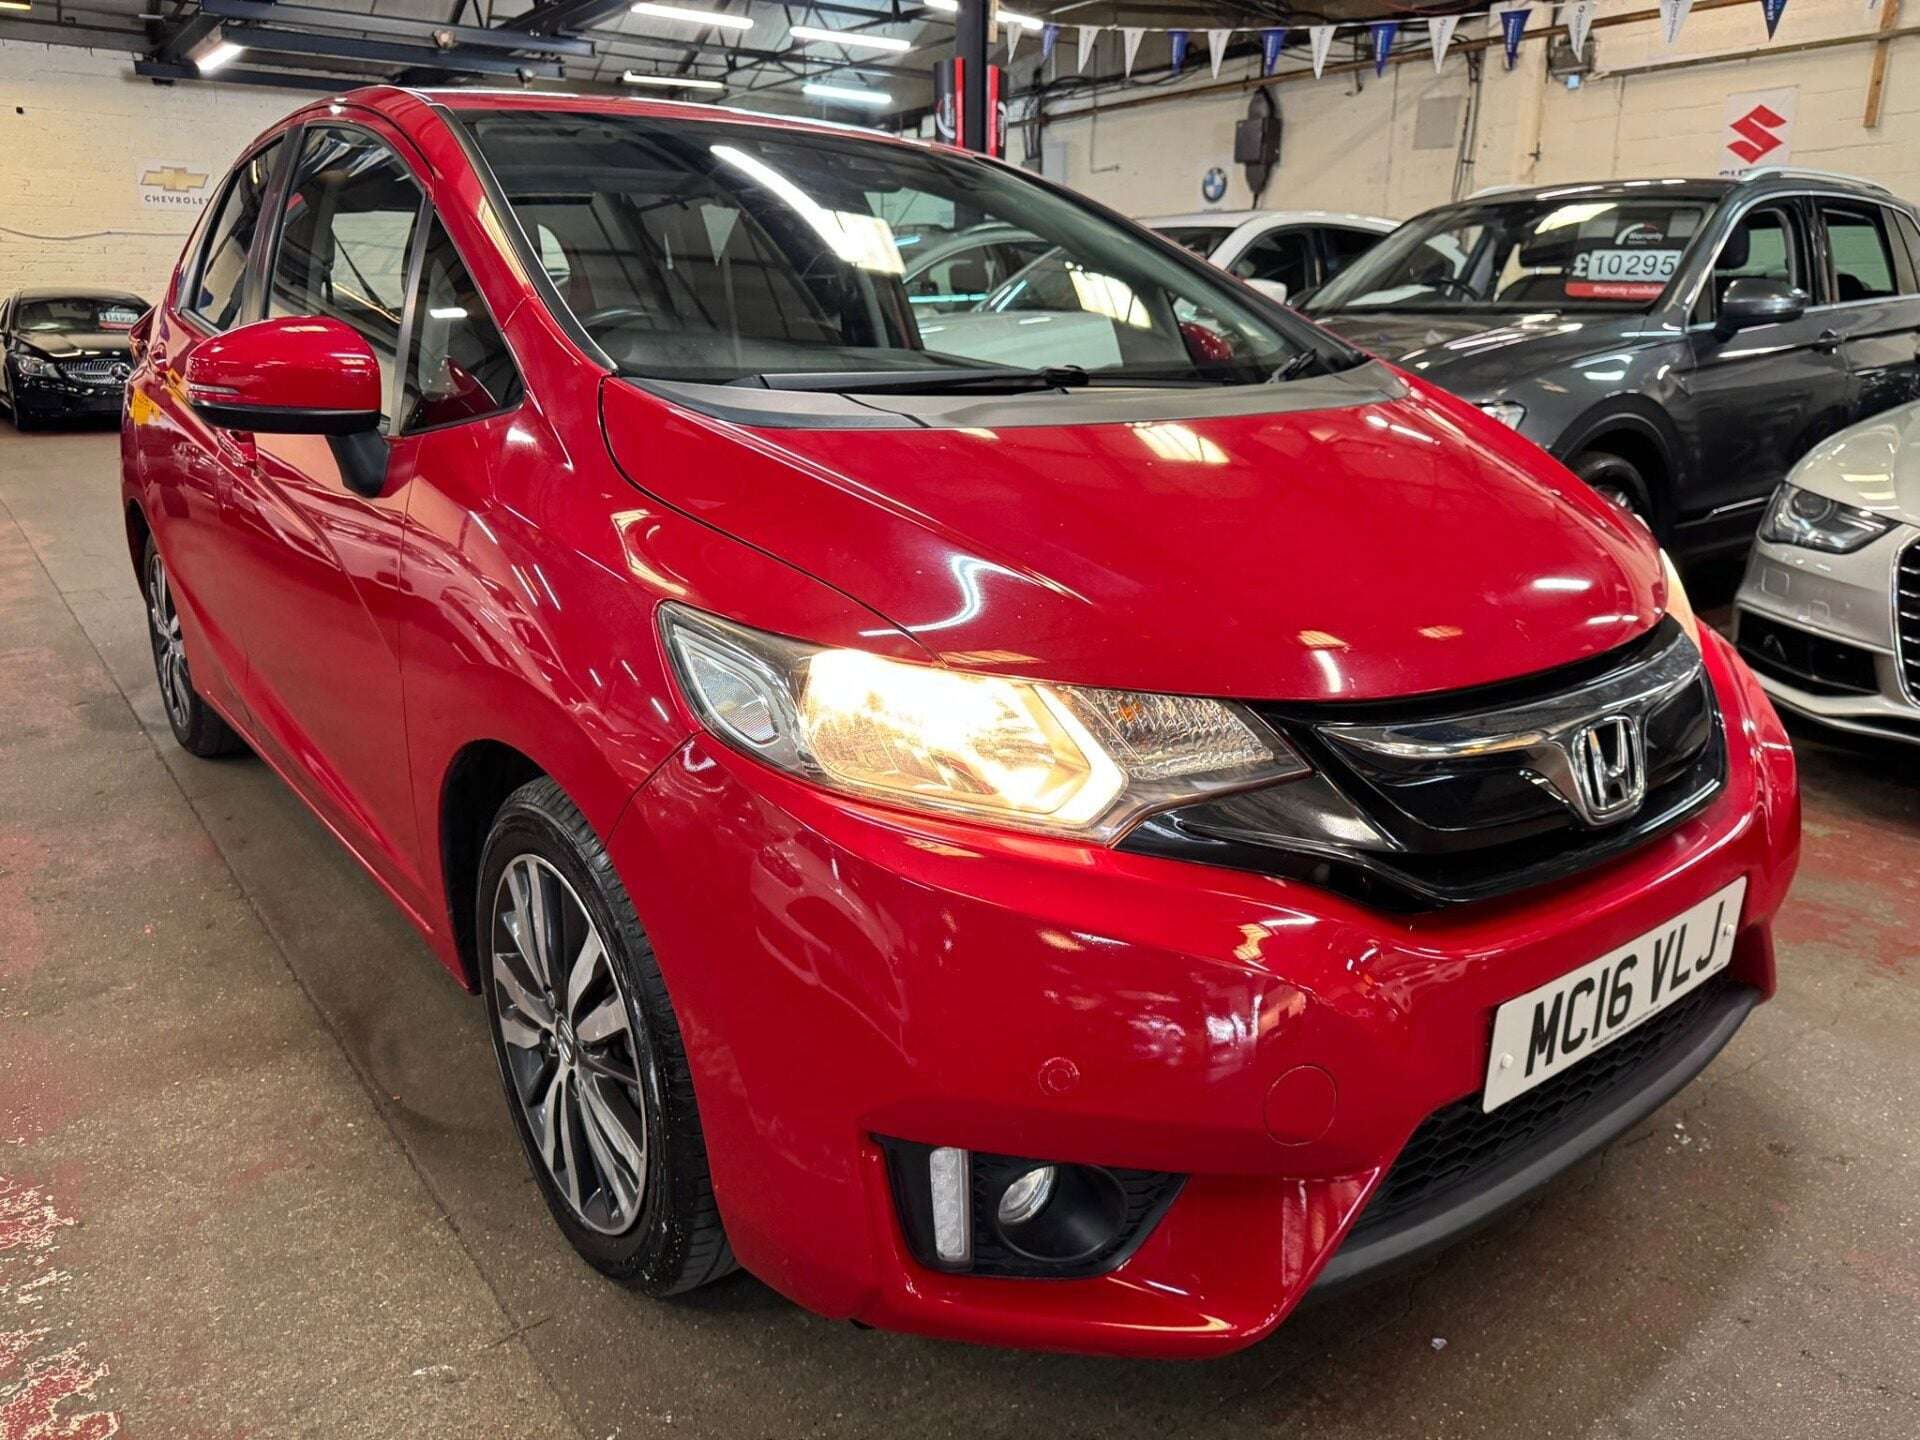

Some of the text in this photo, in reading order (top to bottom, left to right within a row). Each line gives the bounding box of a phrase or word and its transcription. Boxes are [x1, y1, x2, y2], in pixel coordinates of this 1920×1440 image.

[1572, 253, 1677, 276] £10295
[1524, 900, 1725, 1079] MC16 VLJ
